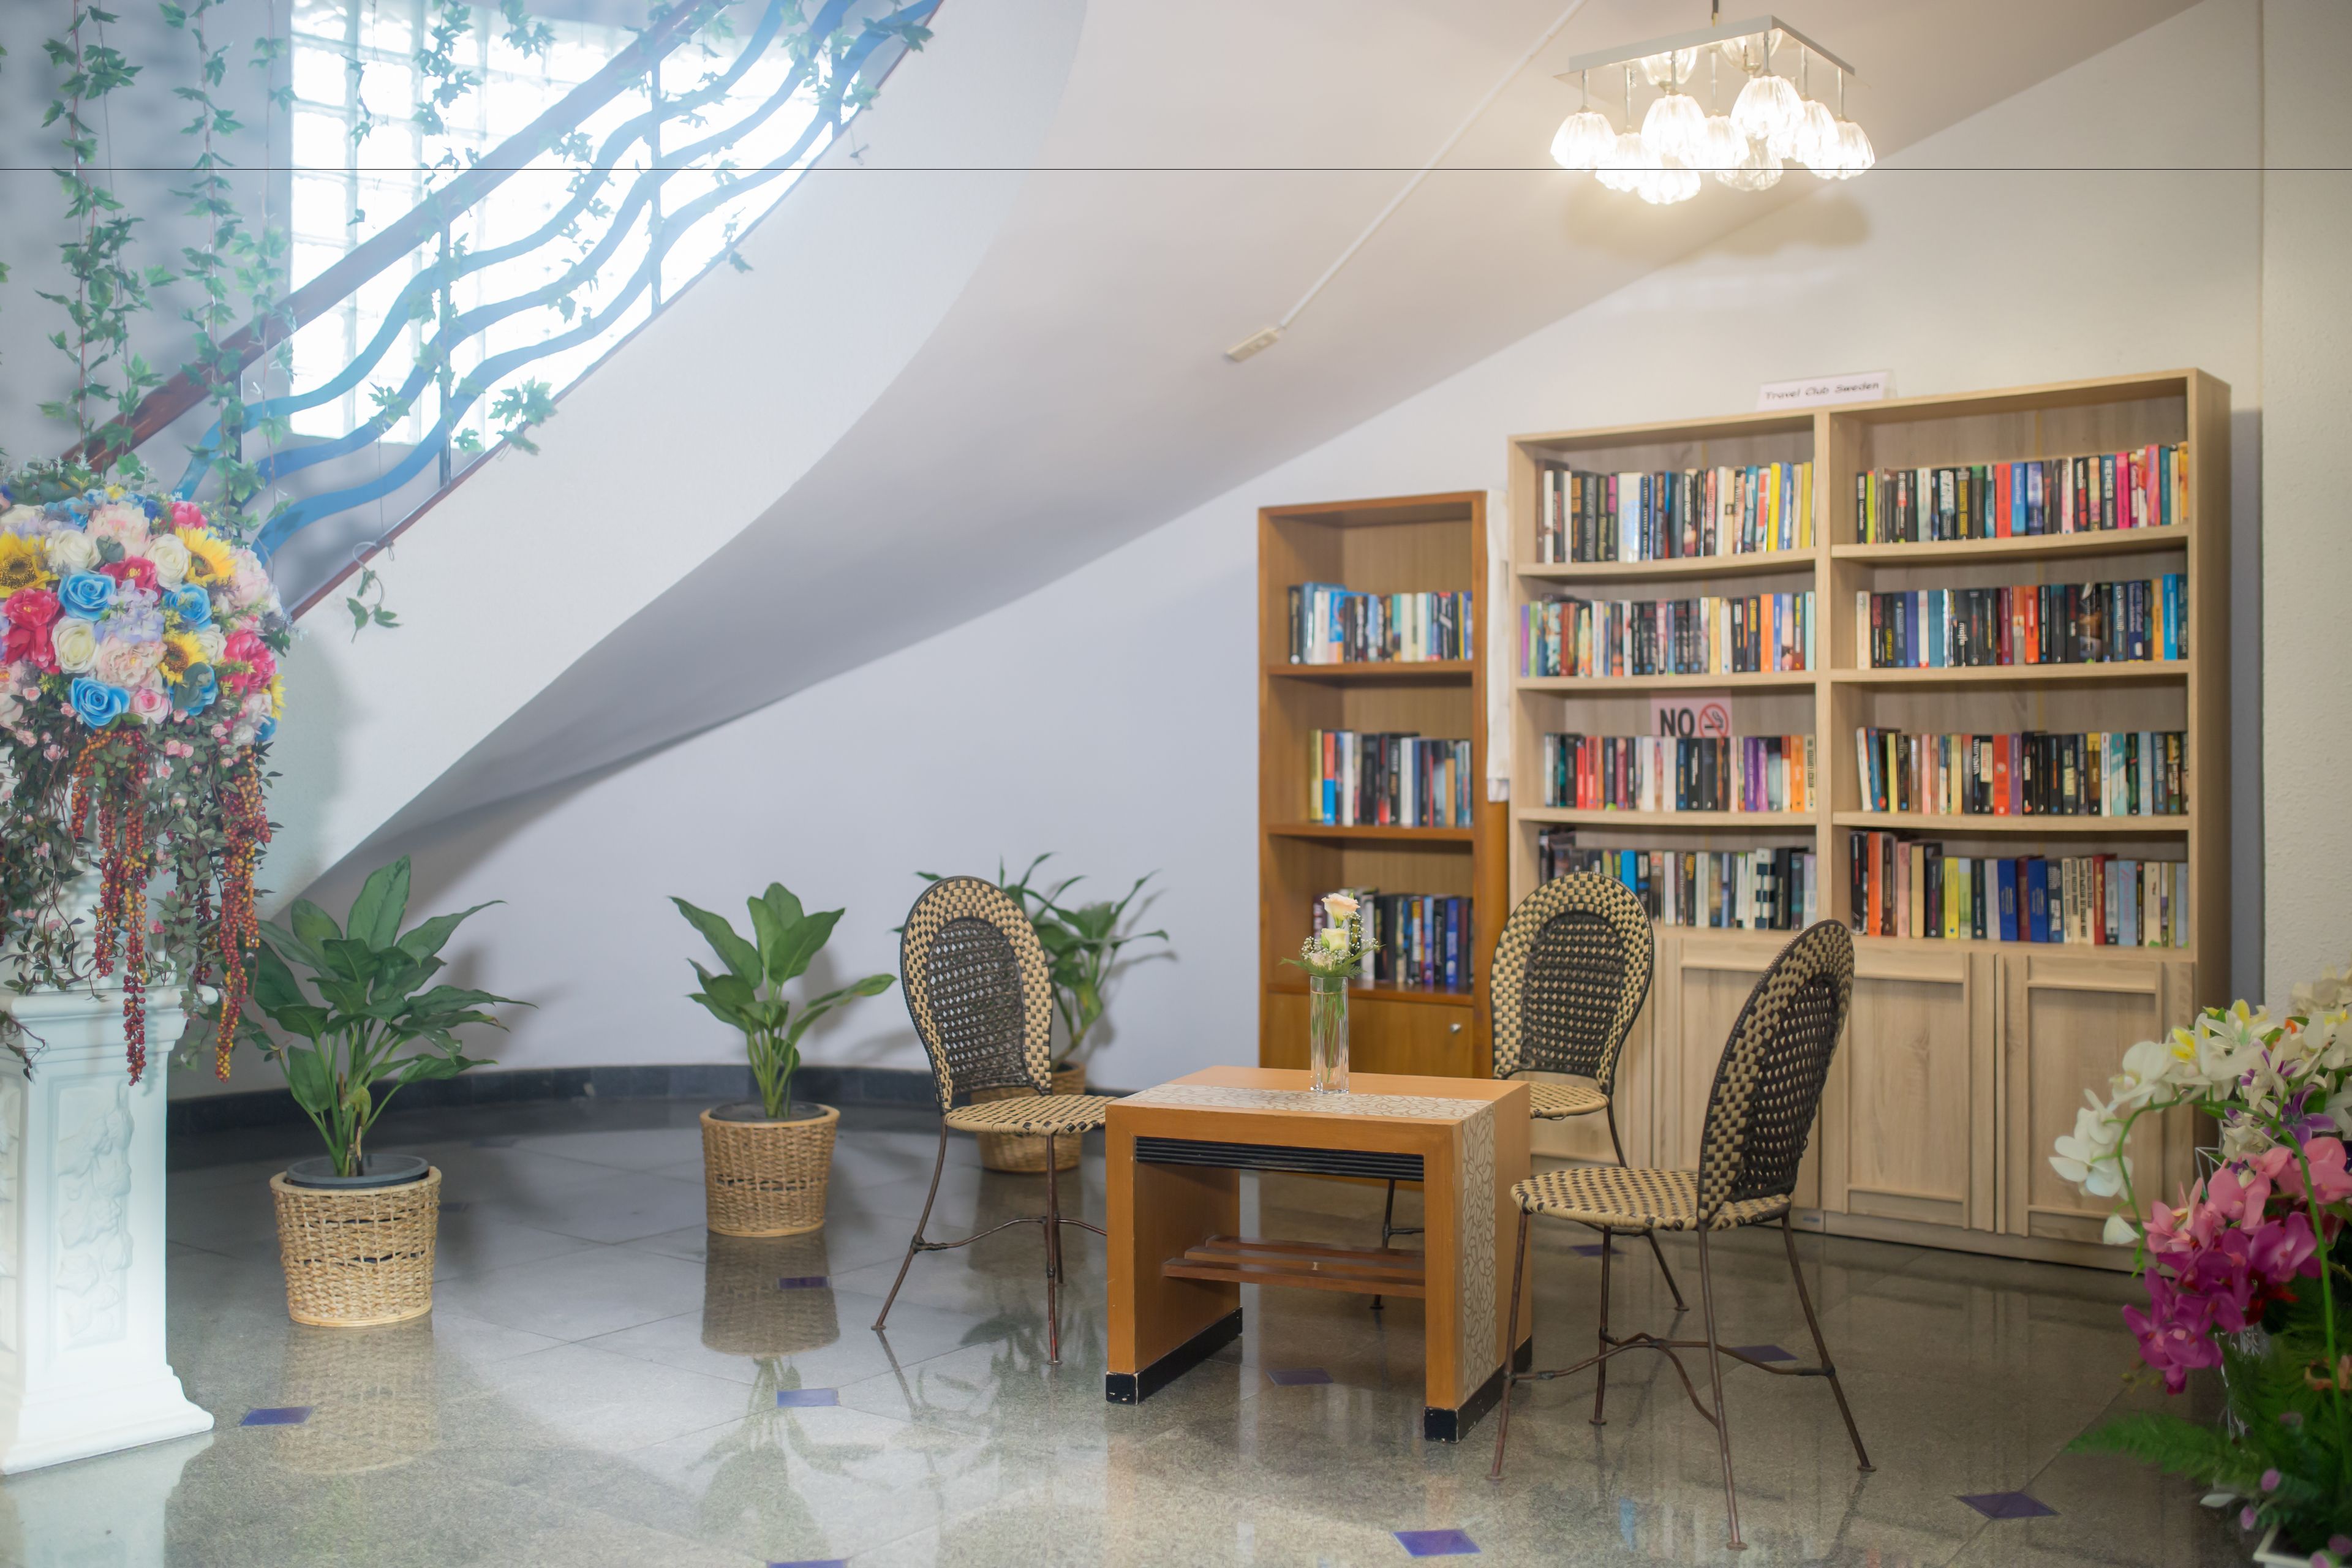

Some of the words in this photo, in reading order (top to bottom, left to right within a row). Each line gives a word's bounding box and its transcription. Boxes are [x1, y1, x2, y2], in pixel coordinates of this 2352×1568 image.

[1765, 389, 1801, 401] Travel
[1805, 386, 1829, 396] Club
[1835, 382, 1879, 394] Sweden
[1660, 708, 1695, 737] NO
